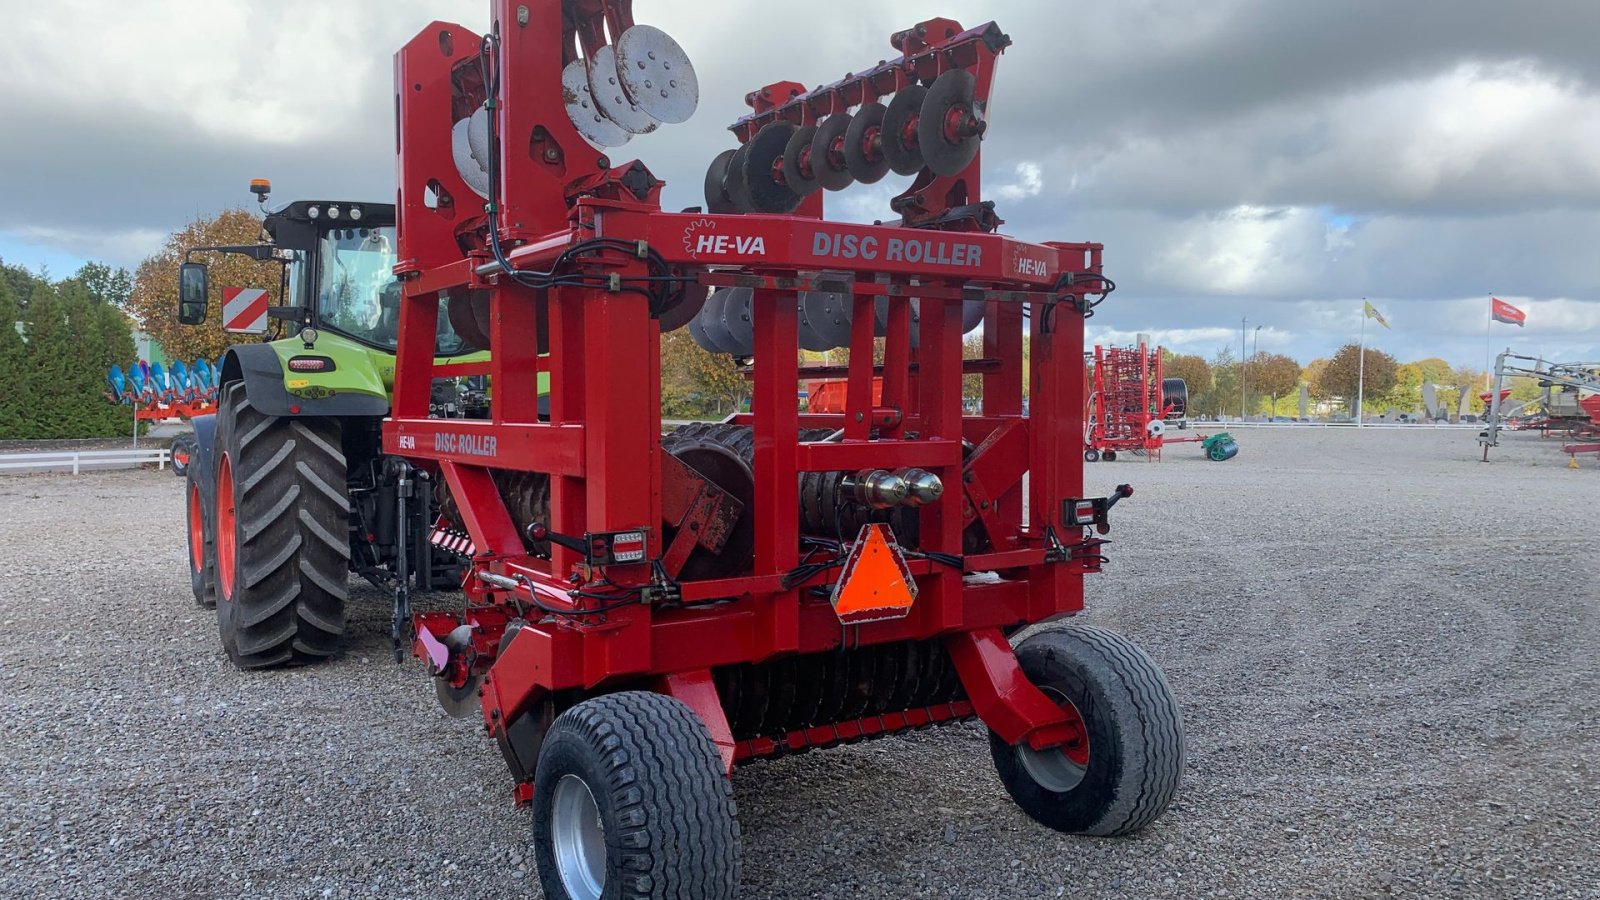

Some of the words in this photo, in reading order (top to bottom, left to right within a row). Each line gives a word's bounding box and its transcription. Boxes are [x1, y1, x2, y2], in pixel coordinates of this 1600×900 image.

[696, 235, 766, 255] HE-VA
[812, 231, 878, 260] DISC
[886, 238, 982, 267] ROLLER
[1018, 257, 1047, 277] HE-VA
[399, 436, 415, 449] HE-VA
[435, 433, 456, 452] DISC
[459, 434, 497, 456] ROLLER
